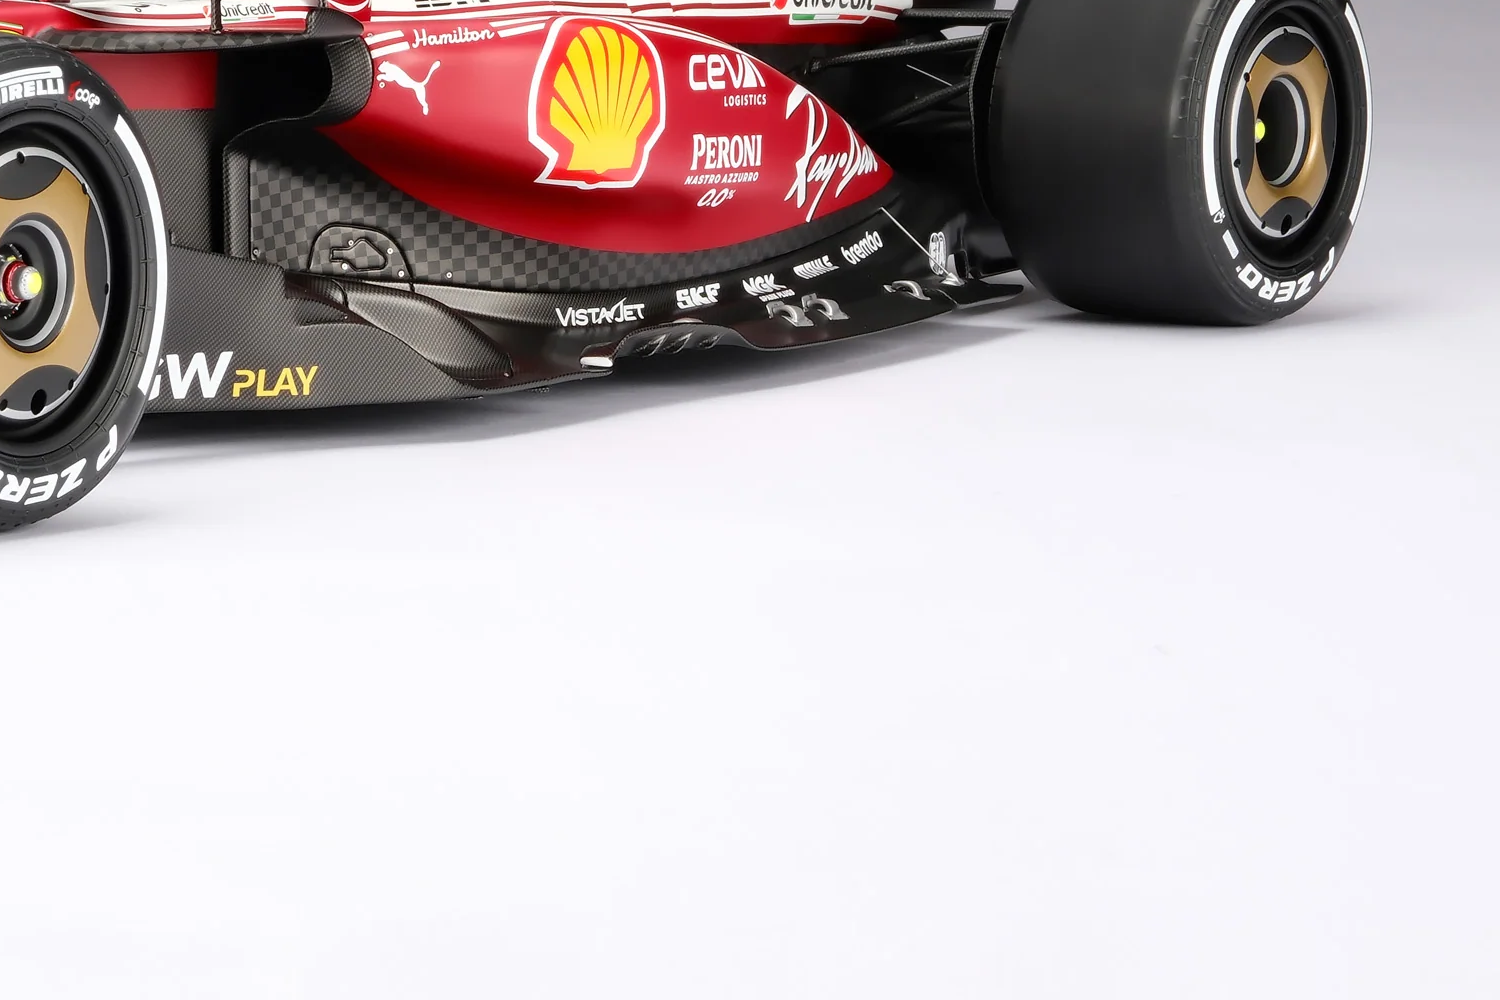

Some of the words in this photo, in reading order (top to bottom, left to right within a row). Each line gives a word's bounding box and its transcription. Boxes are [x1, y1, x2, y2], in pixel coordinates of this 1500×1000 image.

[411, 25, 495, 49] Hamilton
[723, 93, 767, 107] LOGISTICS
[690, 133, 763, 171] PERONI
[684, 173, 721, 186] NASTRO
[721, 171, 759, 184] AZZURRO
[841, 230, 884, 265] brembo
[1318, 246, 1335, 283] P
[675, 282, 721, 310] SKF
[742, 273, 788, 297] NGK
[1238, 262, 1315, 303] ZERO
[232, 365, 319, 398] PLAY
[96, 424, 118, 472] P
